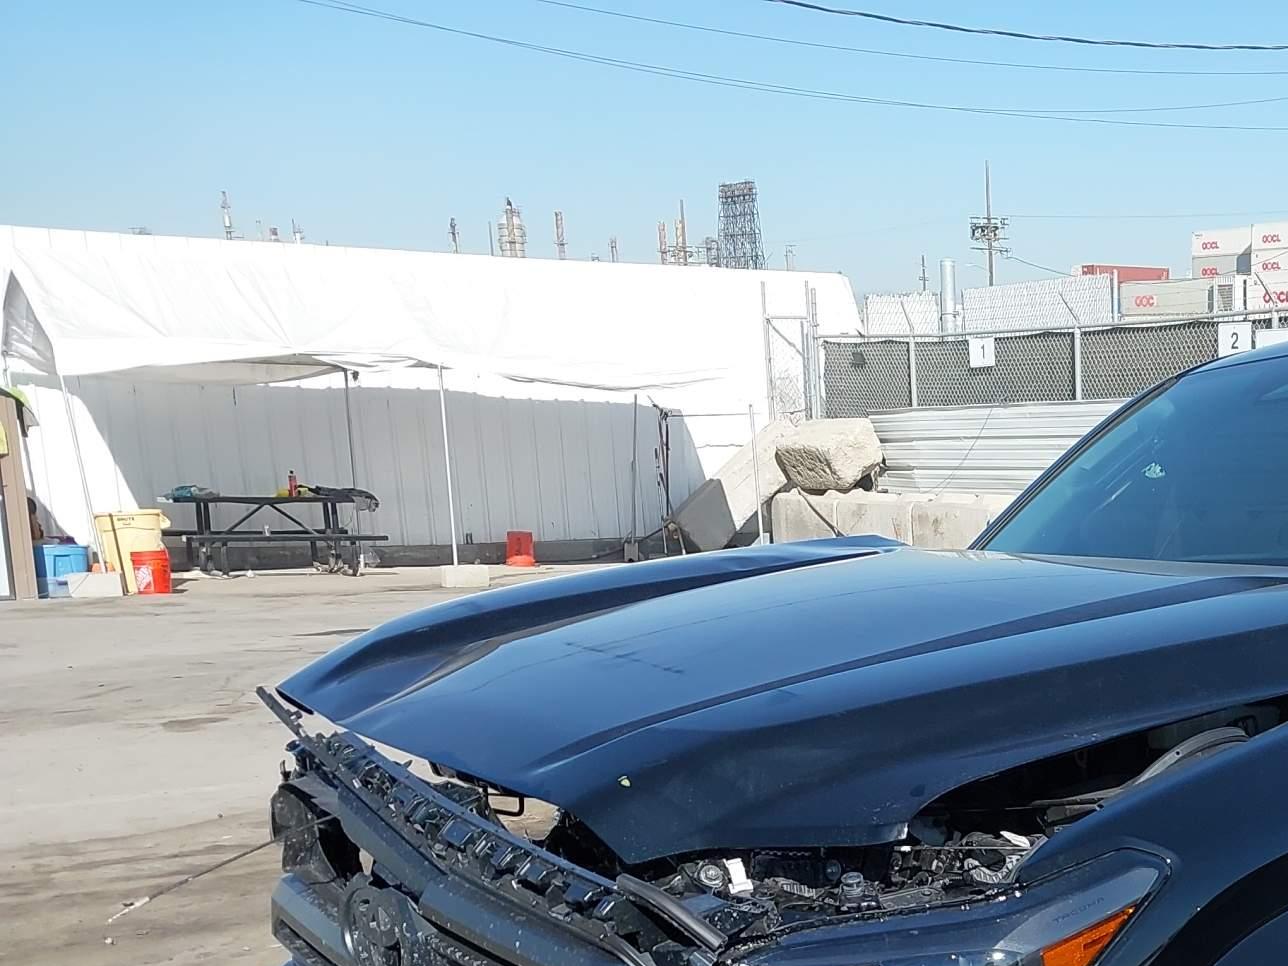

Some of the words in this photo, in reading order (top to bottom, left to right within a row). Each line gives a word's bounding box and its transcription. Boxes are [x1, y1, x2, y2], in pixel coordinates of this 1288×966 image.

[1262, 234, 1281, 243] OOCL
[1201, 241, 1219, 250] OOCL
[1262, 262, 1281, 271] OOCL
[1231, 332, 1239, 350] 2
[980, 344, 985, 359] 1
